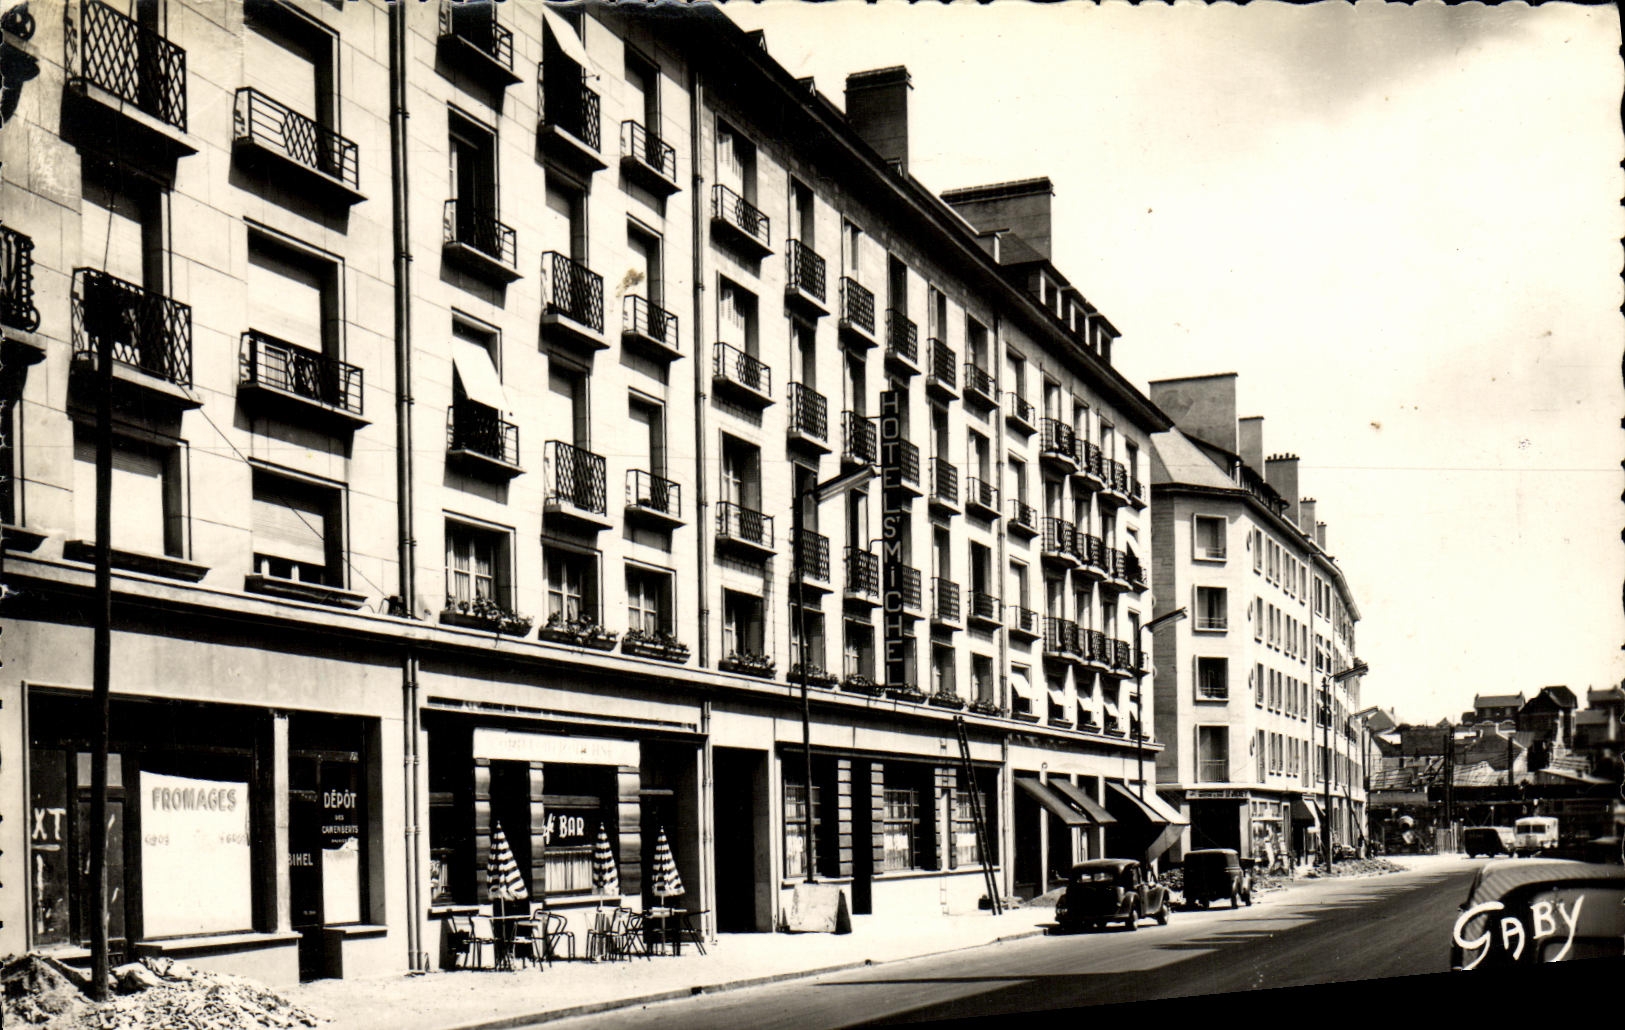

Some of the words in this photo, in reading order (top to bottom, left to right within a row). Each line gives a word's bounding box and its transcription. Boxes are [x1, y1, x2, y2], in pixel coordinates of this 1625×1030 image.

[881, 392, 901, 514] HOTEL
[151, 786, 237, 812] FROMAGES
[323, 789, 357, 809] DÉPÔT
[559, 815, 584, 838] BAR
